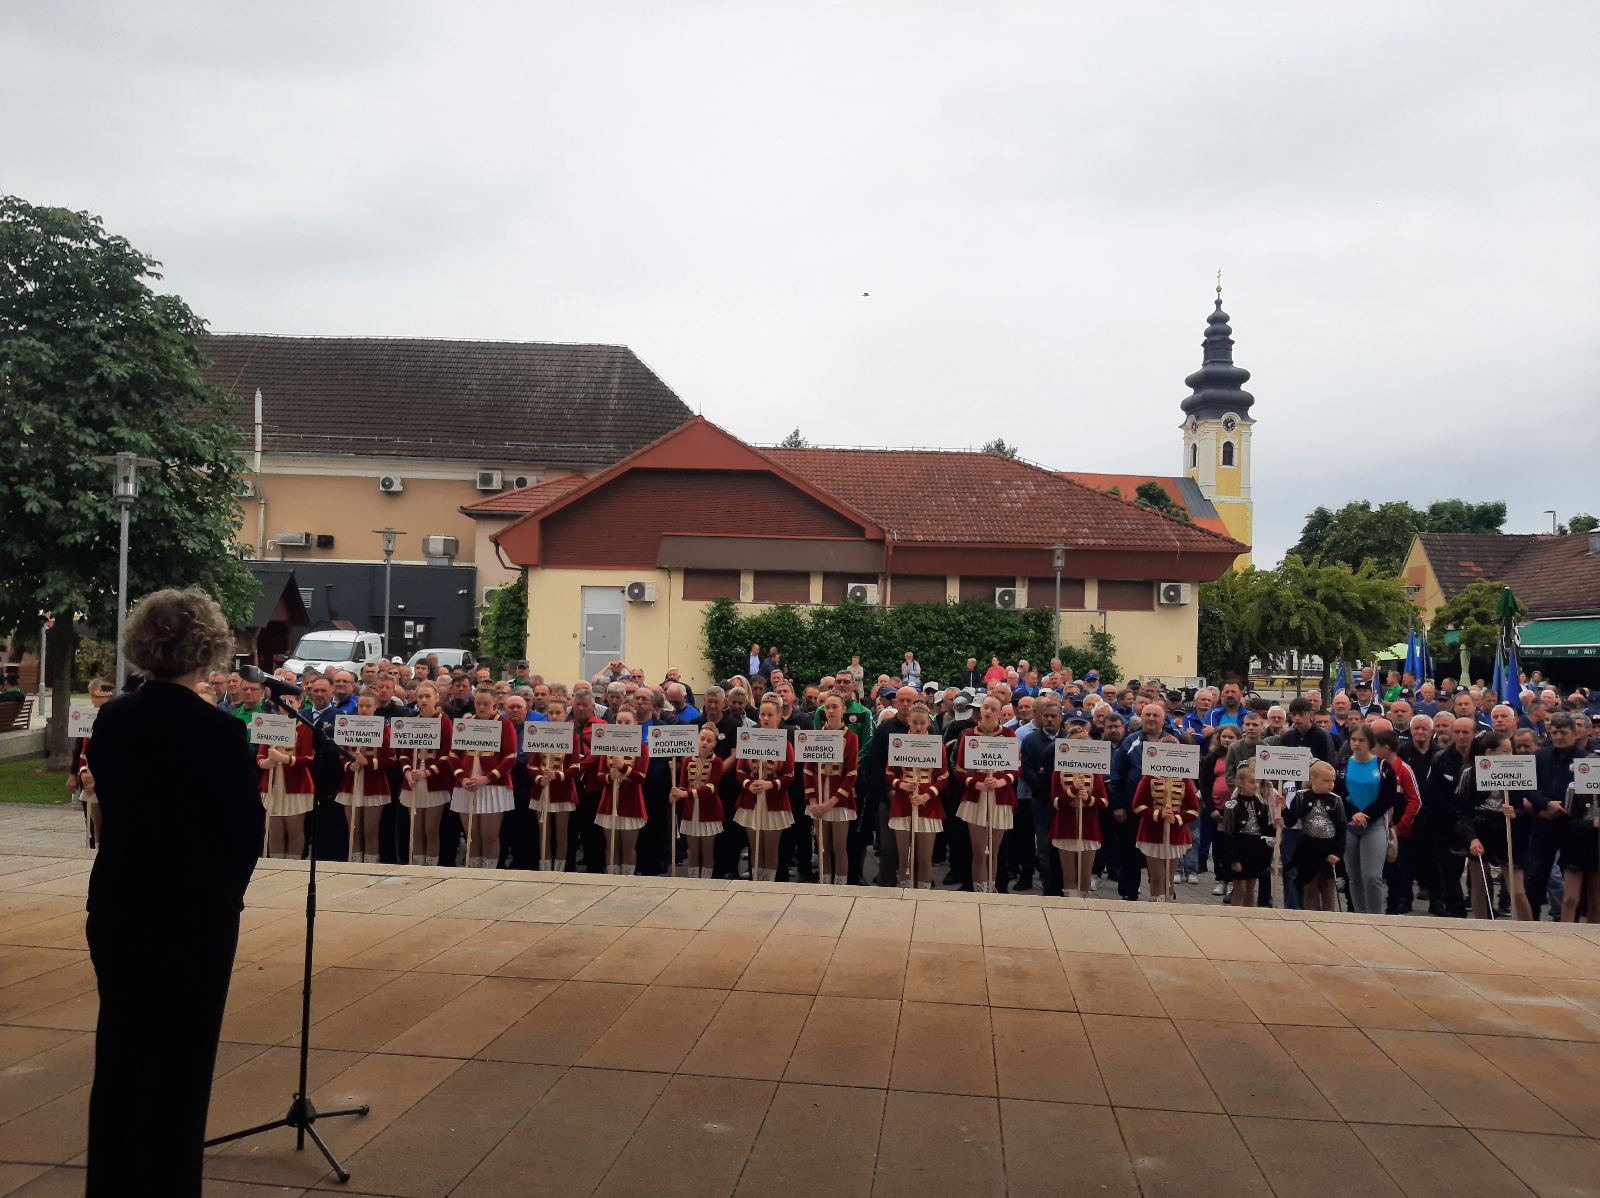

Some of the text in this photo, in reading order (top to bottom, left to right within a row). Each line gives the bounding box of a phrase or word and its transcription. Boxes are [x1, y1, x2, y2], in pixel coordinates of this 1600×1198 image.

[256, 732, 289, 743] ŠENKOVEC
[355, 730, 381, 738] MARTIN
[527, 741, 555, 749] SAVSKA
[594, 745, 638, 753] PRIBISLAVEC
[652, 746, 695, 754] DEKANOVEC
[893, 755, 937, 763] MIHOVLJAN
[981, 752, 1002, 760] MALA
[972, 759, 1011, 767] SUBOTICA
[1057, 759, 1107, 770] KRIŠTANOVEC
[1150, 763, 1191, 774] KOTORIBA
[1263, 768, 1302, 777] IVANOVEC
[1490, 772, 1522, 780] GORNJI
[1480, 779, 1533, 787] MIHALJEVEC
